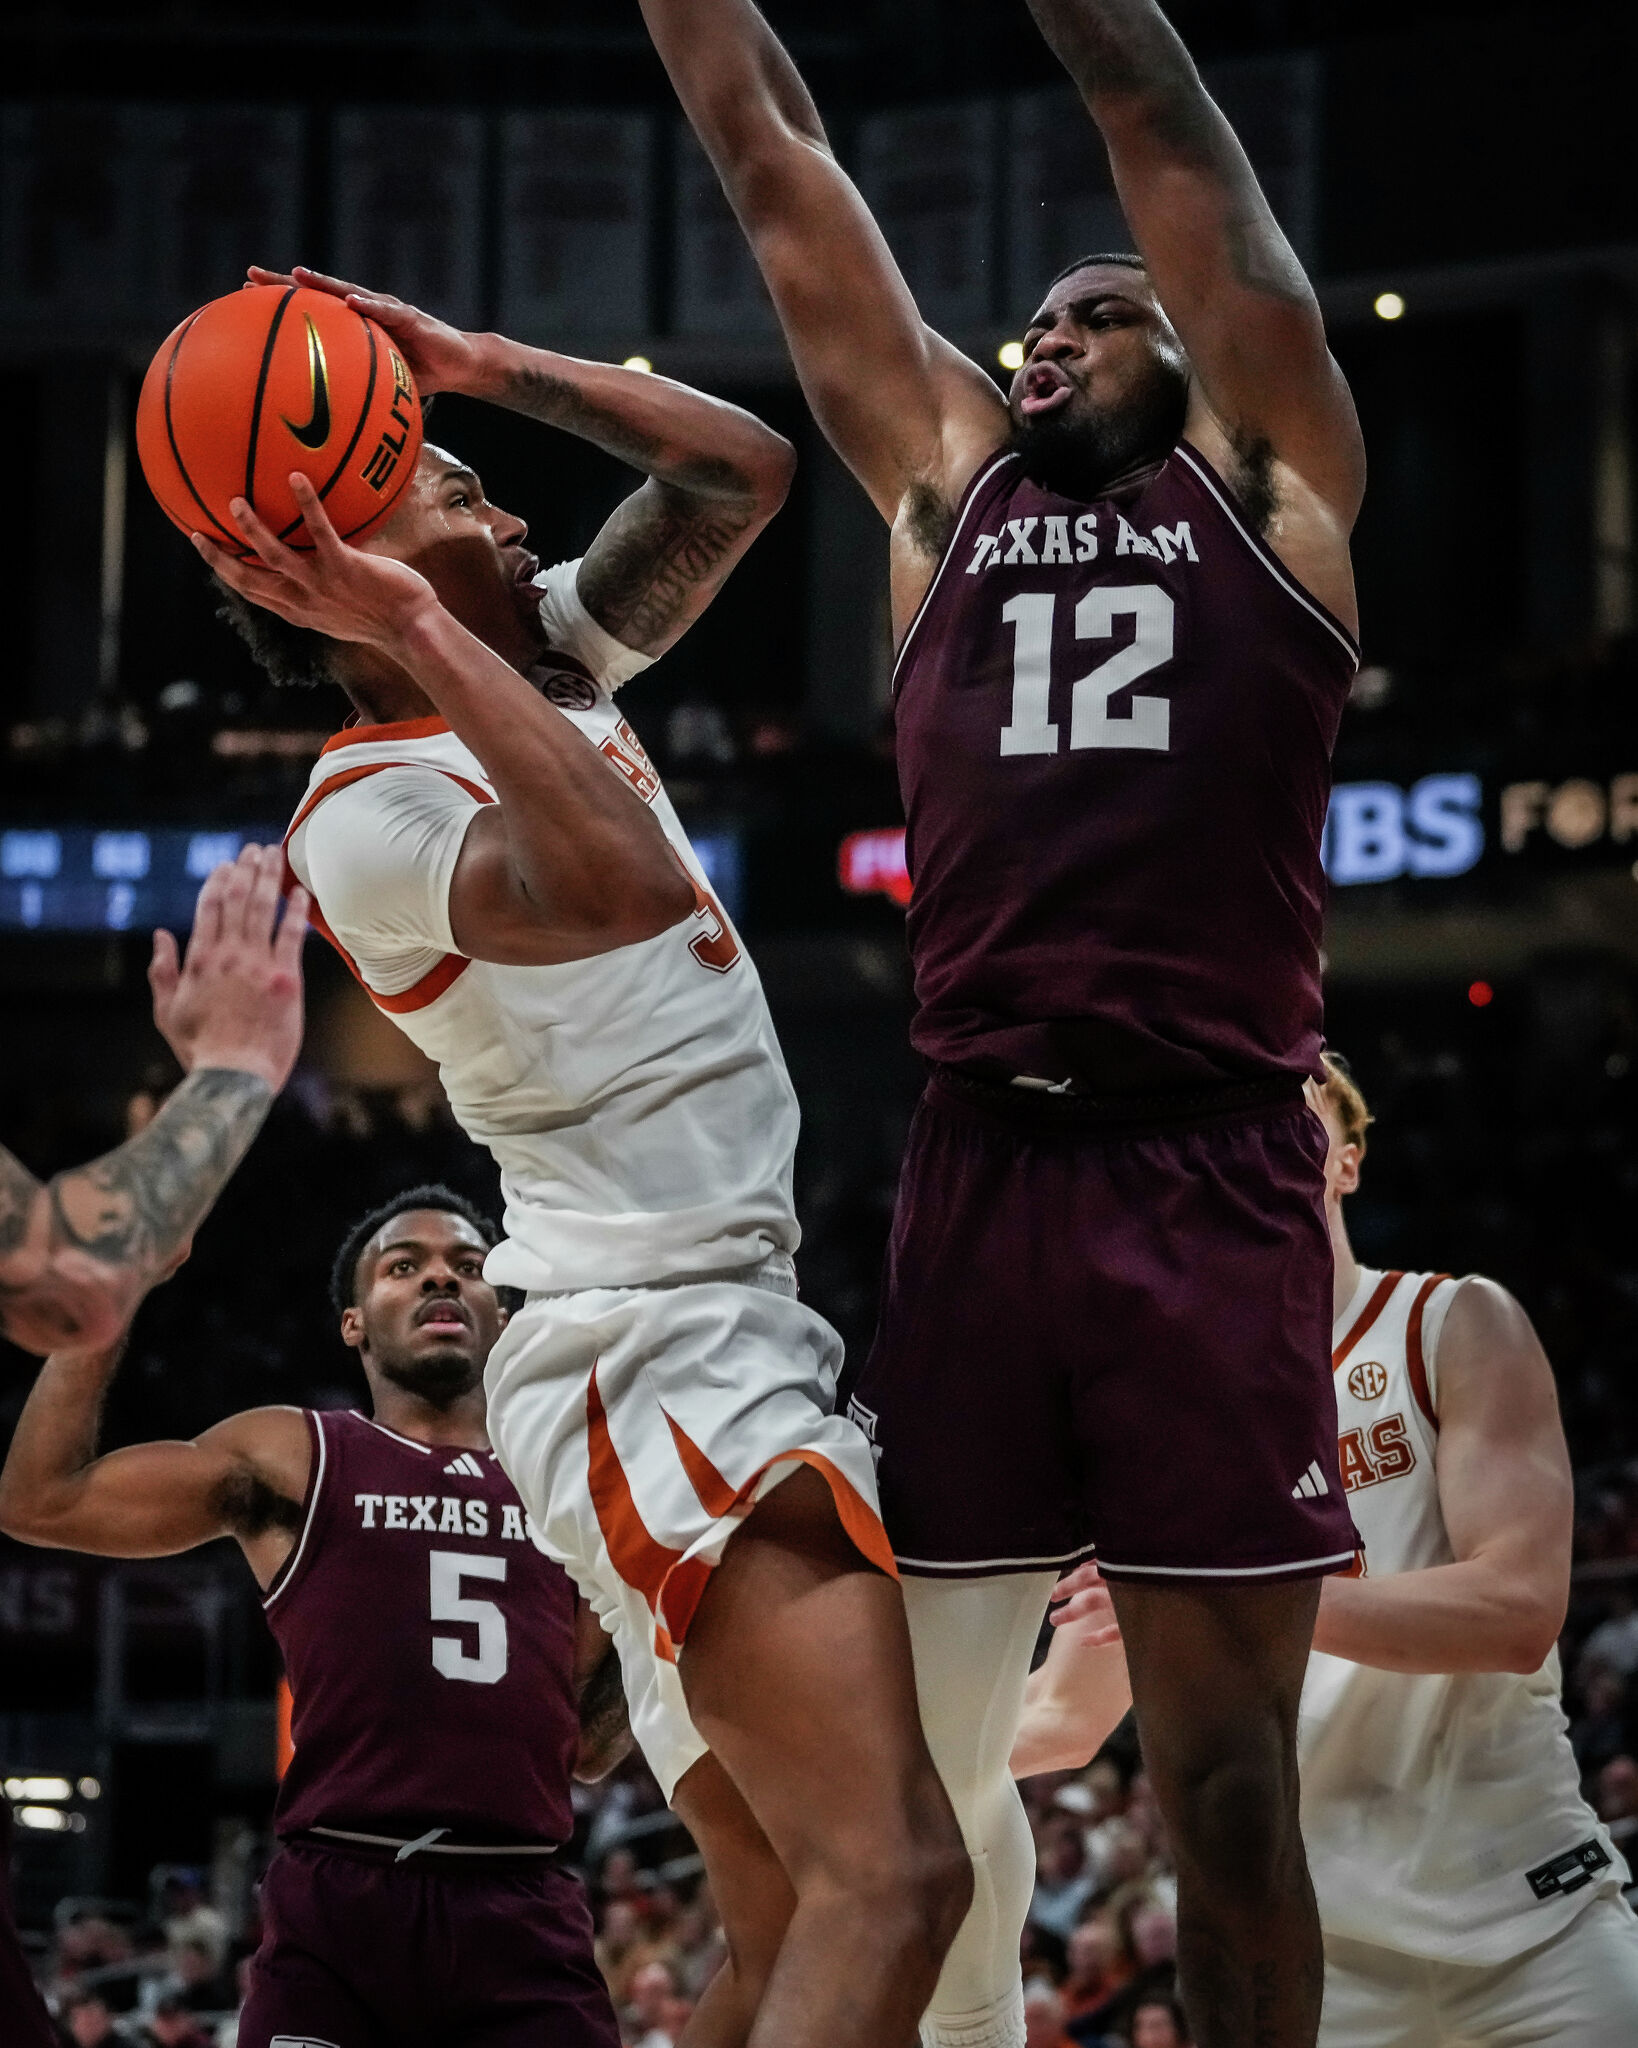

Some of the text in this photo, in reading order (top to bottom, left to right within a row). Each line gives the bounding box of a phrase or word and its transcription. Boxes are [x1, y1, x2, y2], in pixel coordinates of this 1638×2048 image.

[1000, 584, 1175, 757] 12
[1320, 778, 1486, 886] BS
[1348, 1361, 1388, 1401] SEC
[354, 1494, 489, 1538] TEXAS
[429, 1549, 509, 1685] 5
